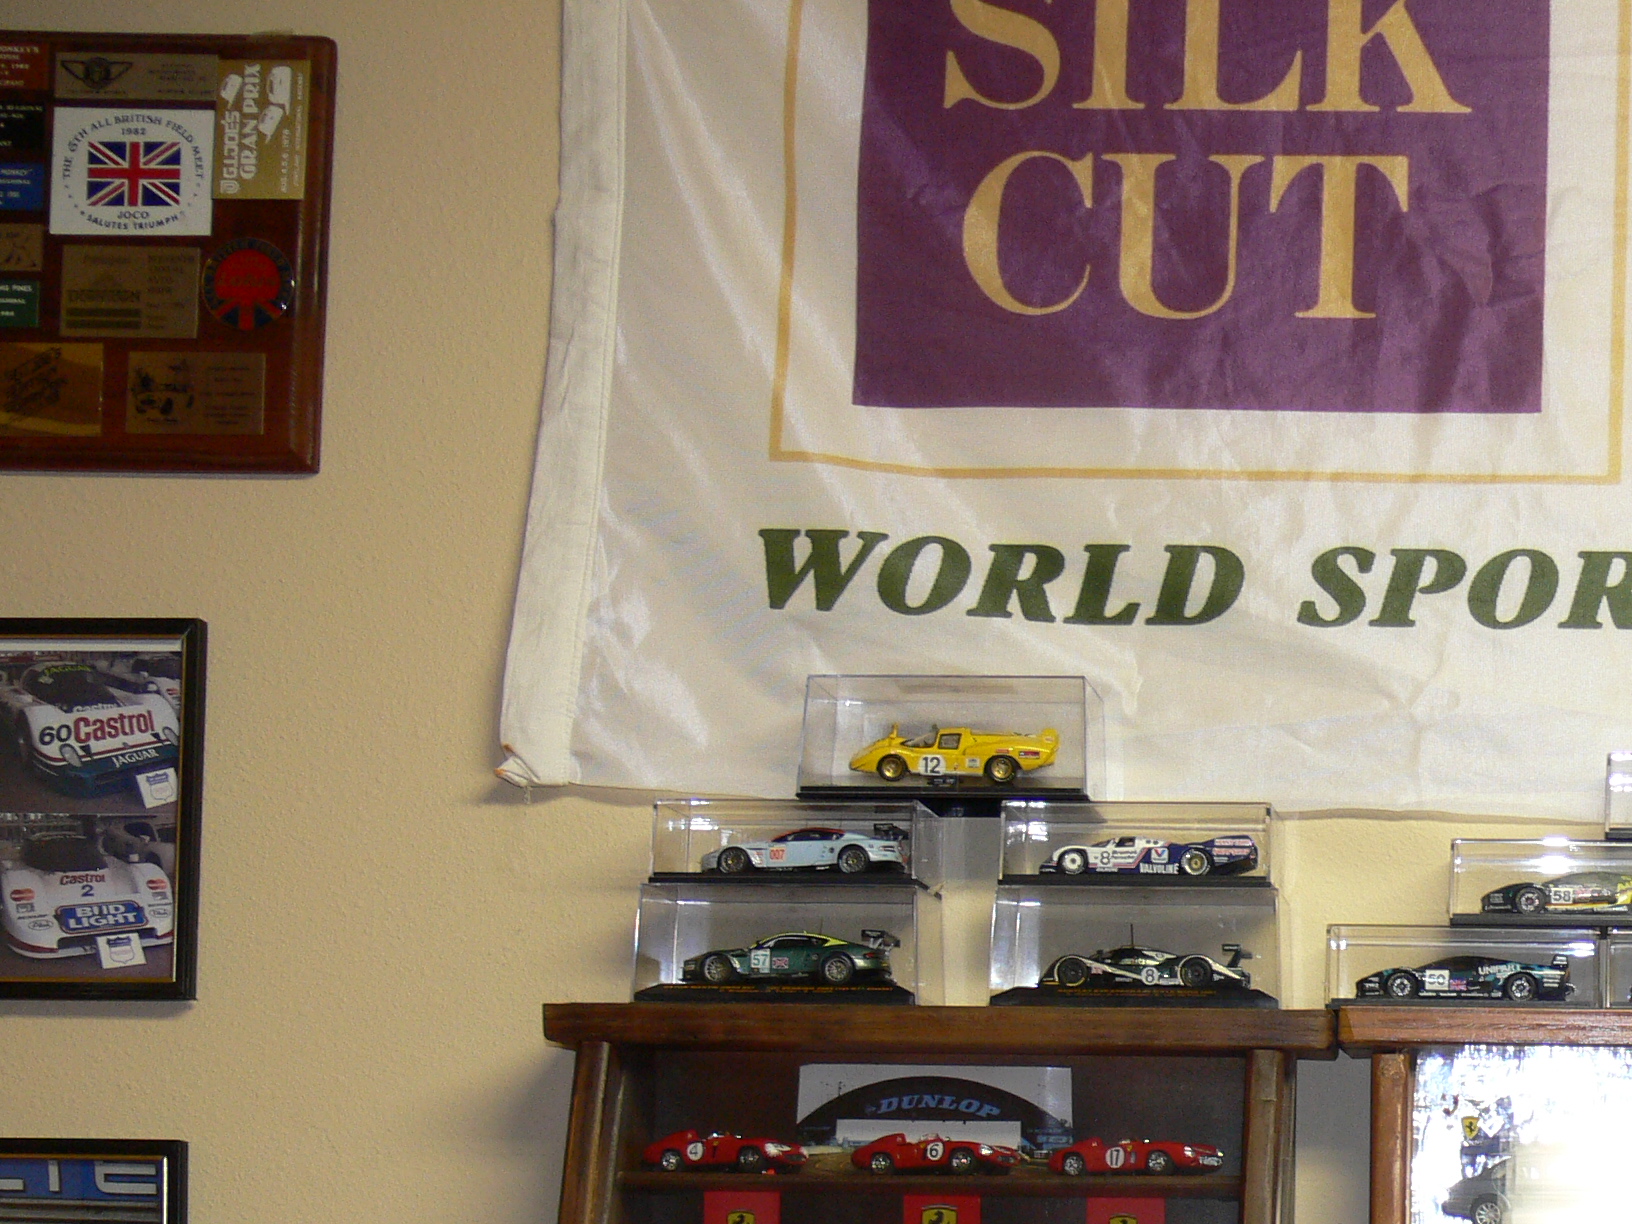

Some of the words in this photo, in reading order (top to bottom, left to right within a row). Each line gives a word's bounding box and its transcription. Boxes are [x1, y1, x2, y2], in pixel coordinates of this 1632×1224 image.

[942, 0, 1471, 113] SILK
[243, 62, 261, 114] PRIX
[62, 155, 73, 181] THE
[90, 117, 115, 132] ALL
[114, 114, 163, 125] BRITISH
[166, 119, 194, 143] FIELD
[191, 145, 205, 179] MEET
[239, 118, 258, 180] GRAN
[86, 214, 129, 230] SALUTES
[133, 214, 179, 230] TRIUMPH
[961, 150, 1410, 321] CUT
[757, 527, 1246, 627] WORLD
[39, 724, 73, 746] 60
[73, 709, 156, 744] Castrol
[111, 748, 160, 768] JAGUAR
[922, 756, 942, 774] 12
[769, 848, 787, 861] 007
[1100, 850, 1111, 866] 8
[1139, 862, 1181, 875] VALVOLINE
[60, 873, 106, 886] Castrol
[81, 884, 95, 897] 2
[1552, 889, 1571, 902] 58
[75, 904, 126, 918] BUD
[68, 912, 138, 929] LIGHT
[751, 954, 770, 968] 57
[1145, 968, 1155, 984] 8
[1477, 963, 1521, 976] UNIPART
[876, 1093, 1002, 1119] DUNLOP
[689, 1143, 699, 1157] 4
[928, 1143, 939, 1158] 6
[1109, 1149, 1120, 1166] 17
